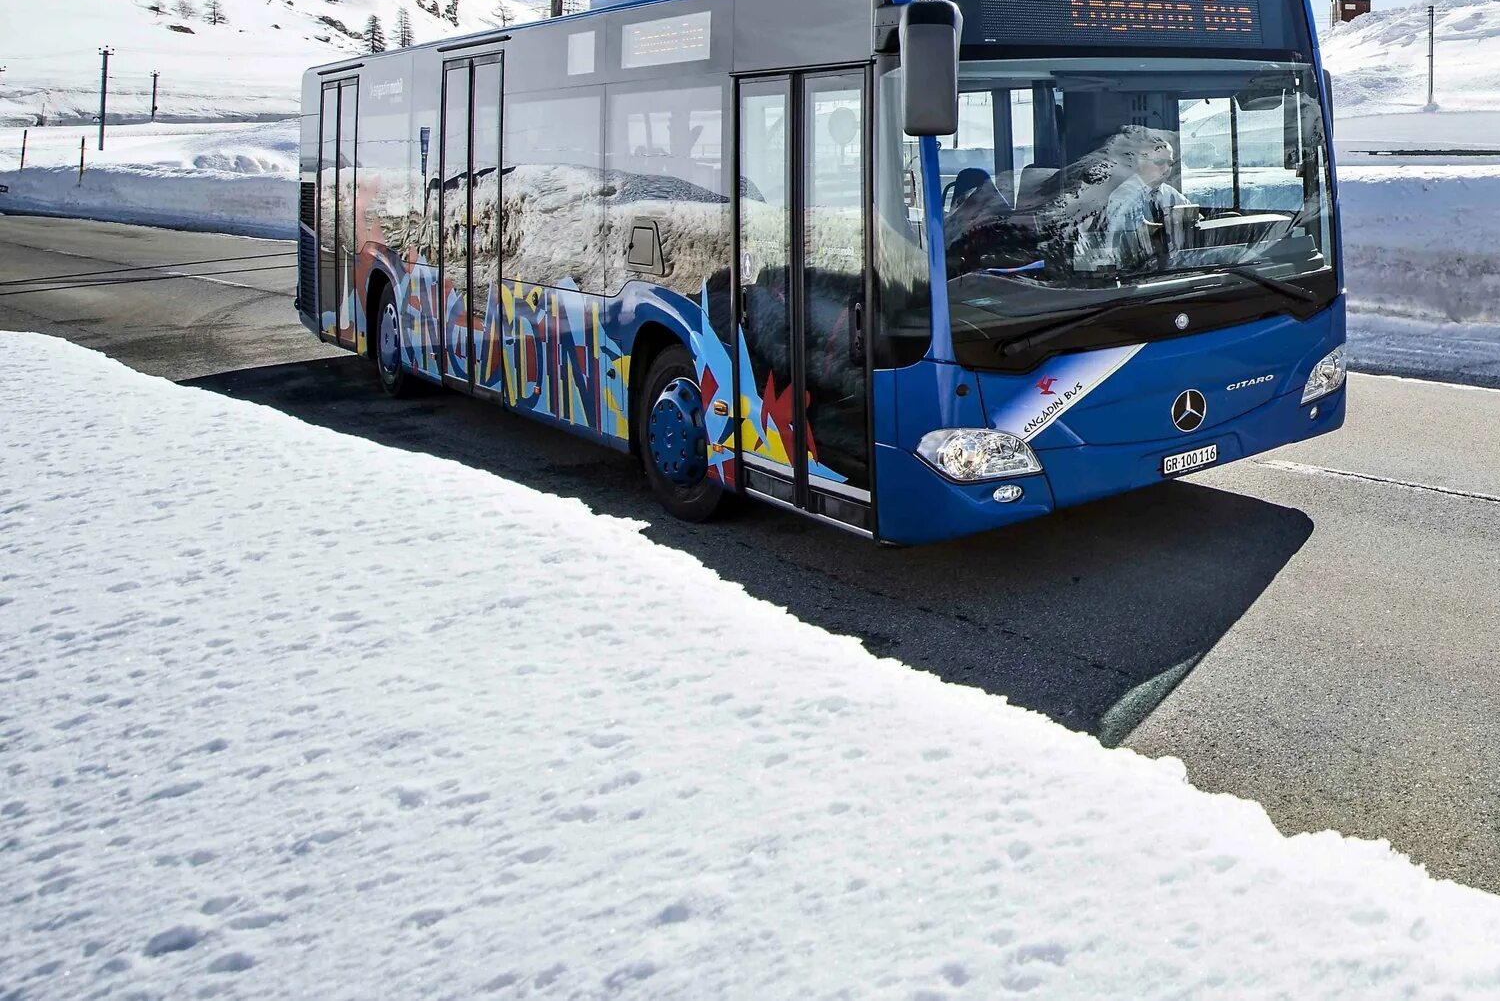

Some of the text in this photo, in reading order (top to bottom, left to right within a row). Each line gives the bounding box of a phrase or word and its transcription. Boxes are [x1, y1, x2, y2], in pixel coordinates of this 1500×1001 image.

[1226, 374, 1275, 391] CITARO
[1024, 382, 1083, 433] ENGADIN BUS
[1199, 446, 1216, 463] 116
